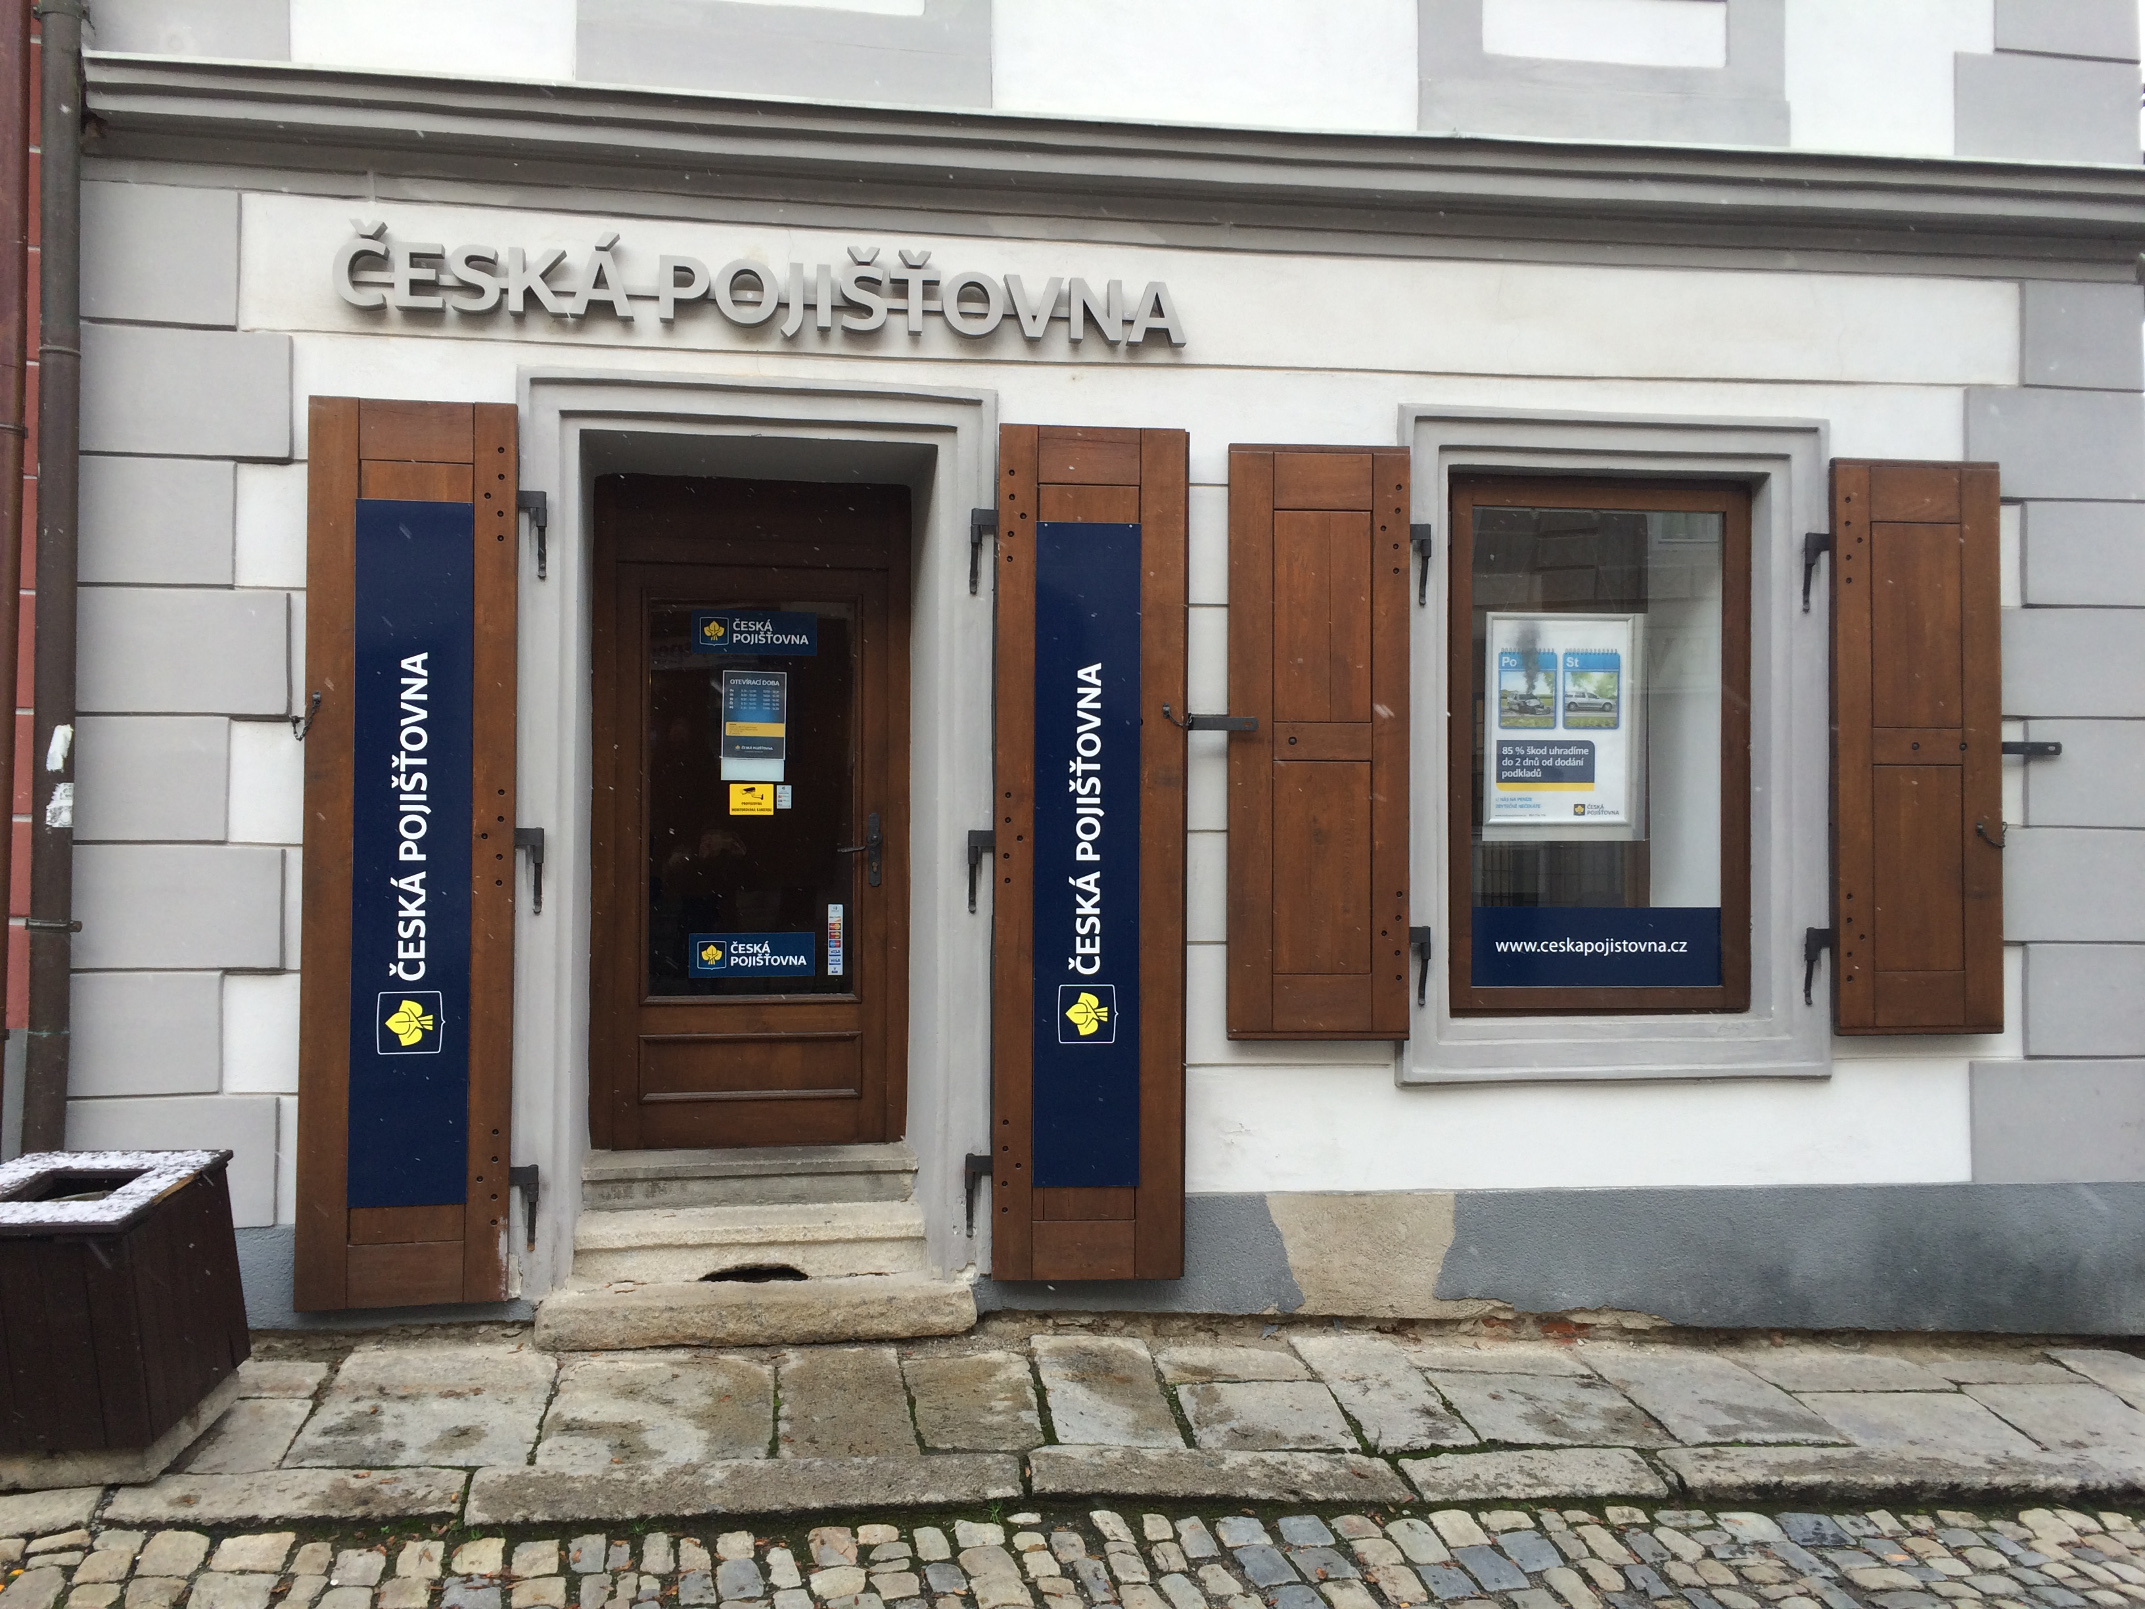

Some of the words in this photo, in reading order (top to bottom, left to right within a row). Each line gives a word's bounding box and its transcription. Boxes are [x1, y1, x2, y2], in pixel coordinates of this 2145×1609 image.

[331, 219, 634, 322] ČESKÁ
[658, 246, 1187, 348] POJIŠŤOVNA
[732, 618, 773, 632] ČESKÁ
[732, 631, 809, 645] POJIŠŤOVNA
[1501, 656, 1518, 667] Po
[1566, 657, 1579, 667] St
[391, 652, 429, 862] POJIŠŤOVNA
[1501, 746, 1513, 755] 85
[1515, 746, 1525, 755] %
[1526, 746, 1547, 755] škod
[1549, 746, 1590, 755] uhradíme
[1068, 662, 1104, 862] POJIŠŤOVNA
[1501, 757, 1514, 766] do
[1515, 758, 1521, 766] 2
[1522, 757, 1540, 766] dnů
[1541, 757, 1553, 766] od
[1554, 757, 1584, 766] dodání
[1501, 768, 1542, 779] podkladů
[389, 871, 428, 982] ČESKÁ
[1068, 871, 1102, 975] ČESKÁ
[730, 941, 771, 954] ČESKÁ
[1495, 936, 1688, 957] www.ceskapojistovna.cz
[730, 953, 807, 967] POJIŠŤOVNA
